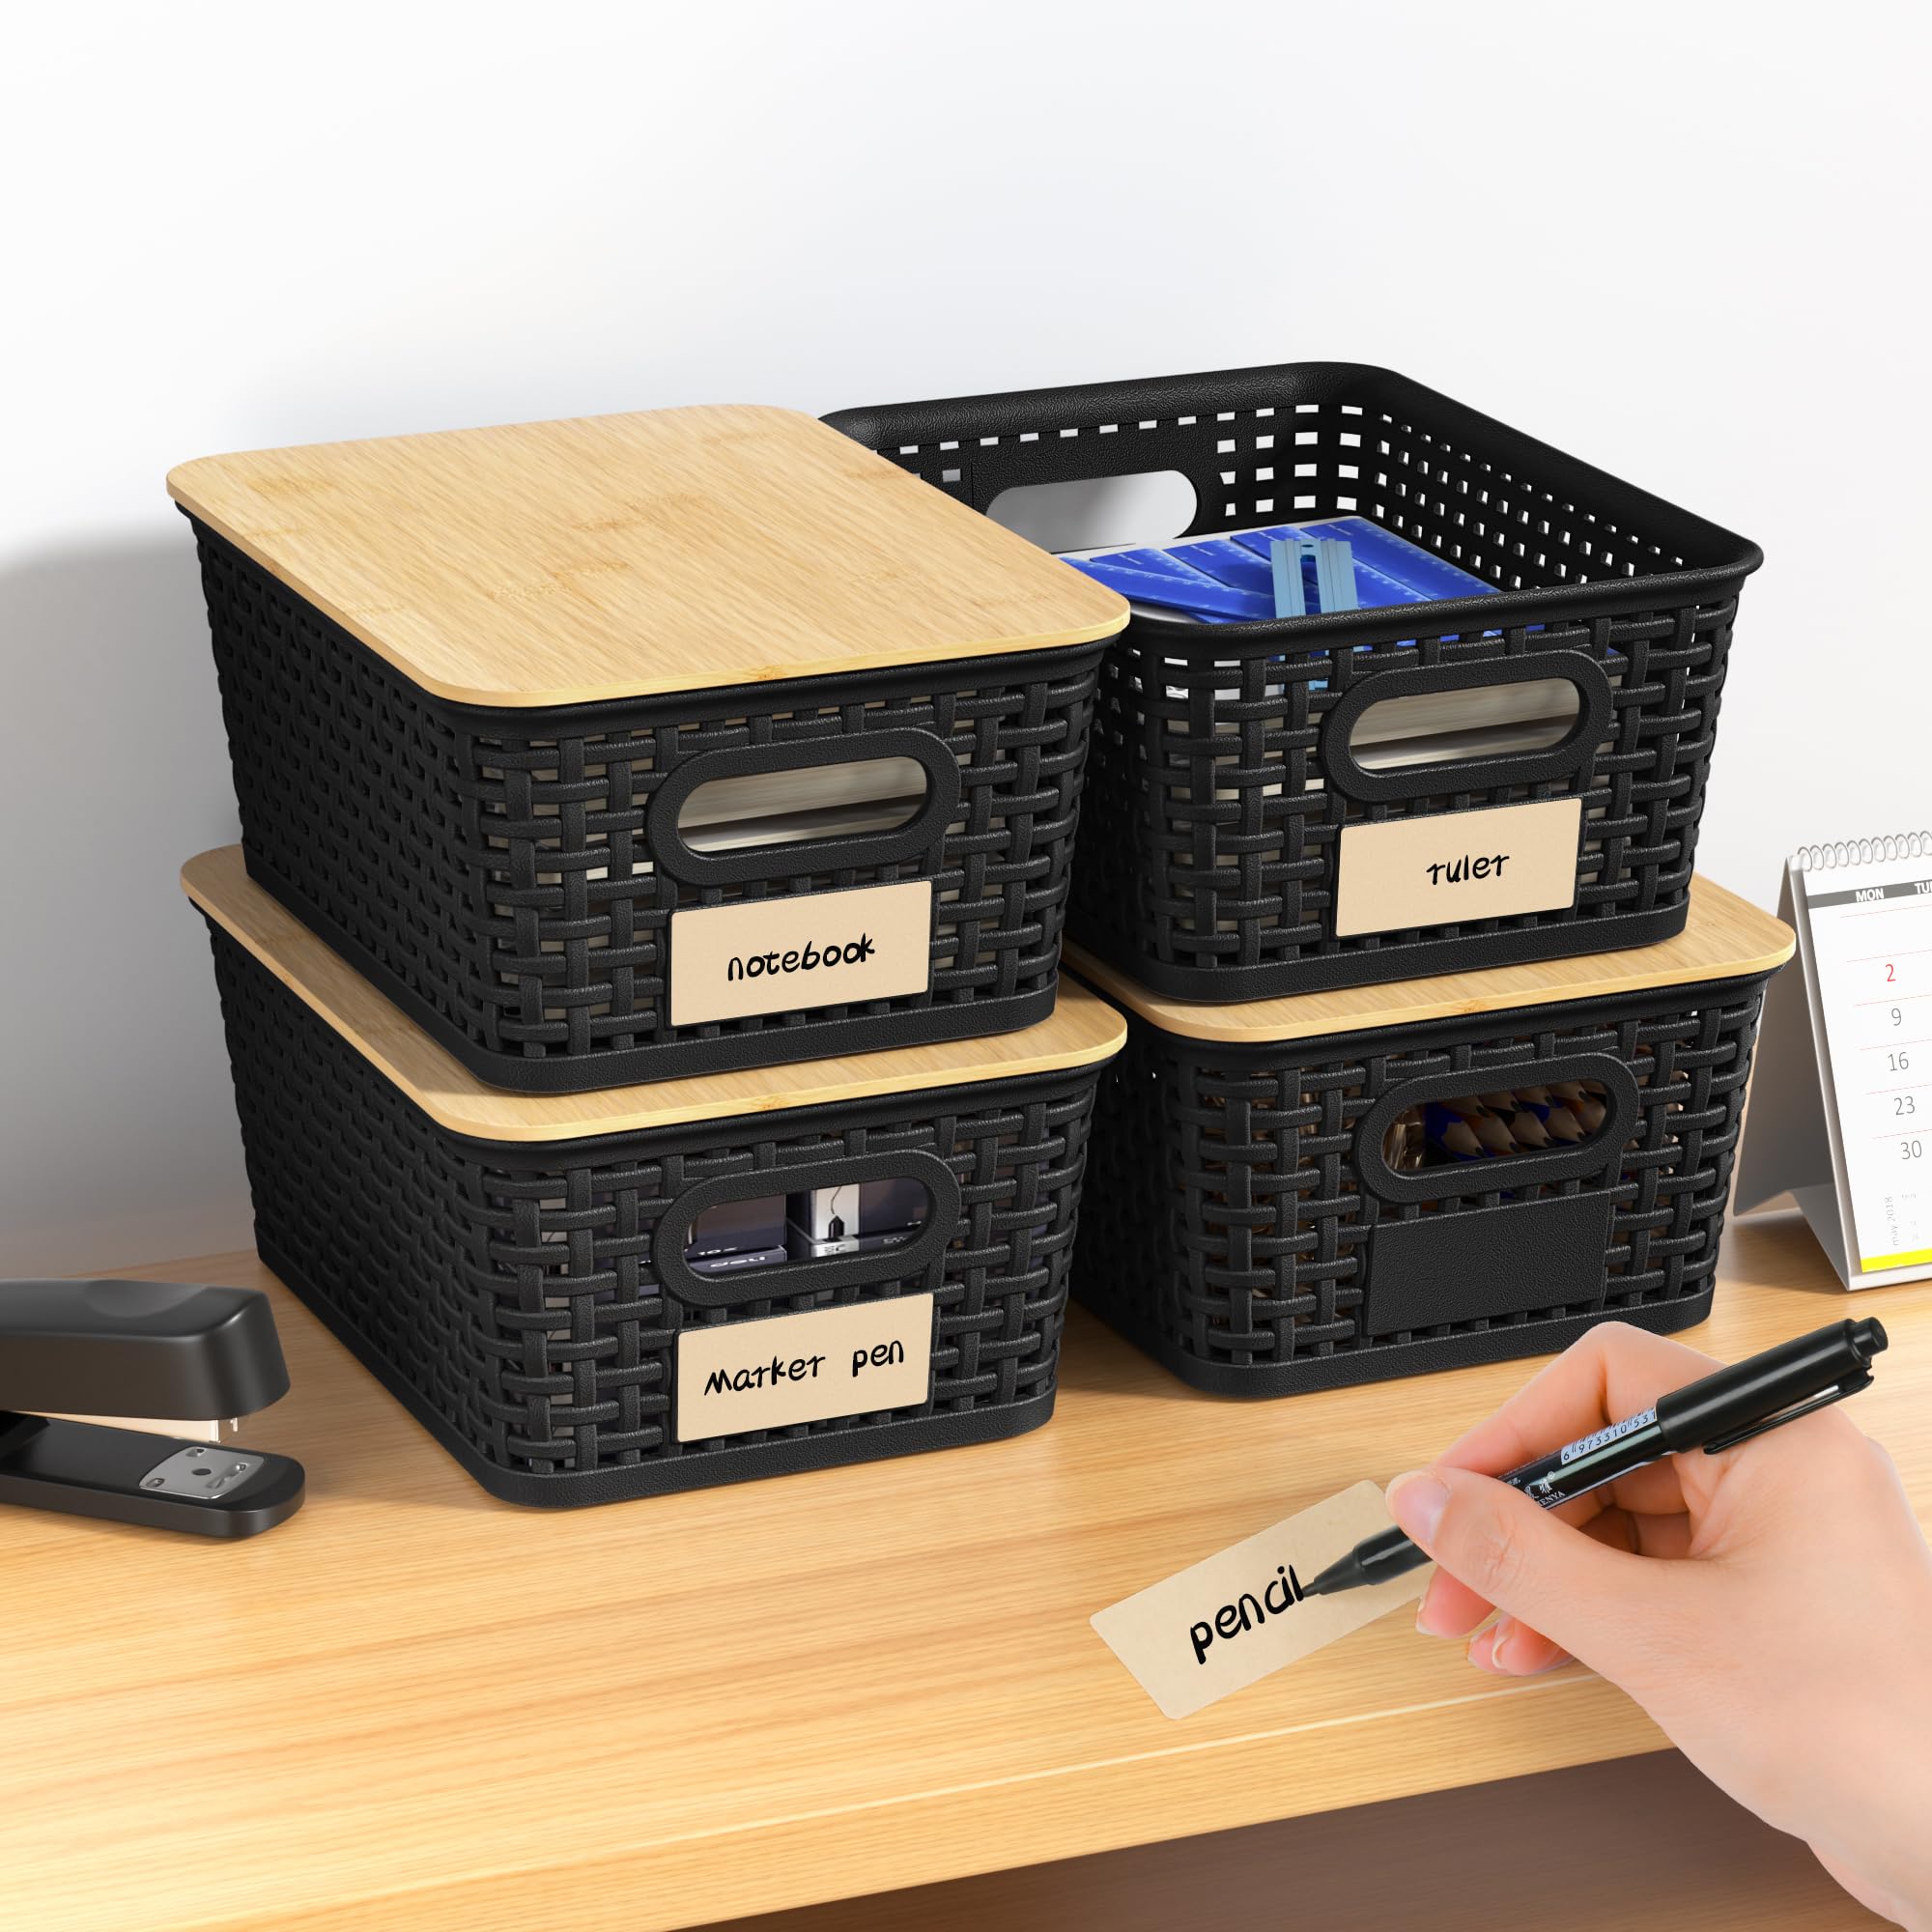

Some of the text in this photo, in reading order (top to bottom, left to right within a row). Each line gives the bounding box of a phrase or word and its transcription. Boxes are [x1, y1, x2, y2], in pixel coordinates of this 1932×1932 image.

[1426, 854, 1510, 886] ruler
[1855, 888, 1885, 902] MON
[727, 932, 876, 981] notebook
[1885, 963, 1897, 982] 2
[1890, 1008, 1902, 1027] 9
[1888, 1051, 1910, 1072] 16
[1893, 1095, 1916, 1116] 23
[1900, 1140, 1922, 1160] 30
[1884, 1195, 1896, 1222] 2018
[703, 1340, 904, 1397] Marker pen
[1578, 1424, 1627, 1454] 973310
[1538, 1491, 1566, 1506] ENYA
[1190, 1563, 1305, 1665] pencil
